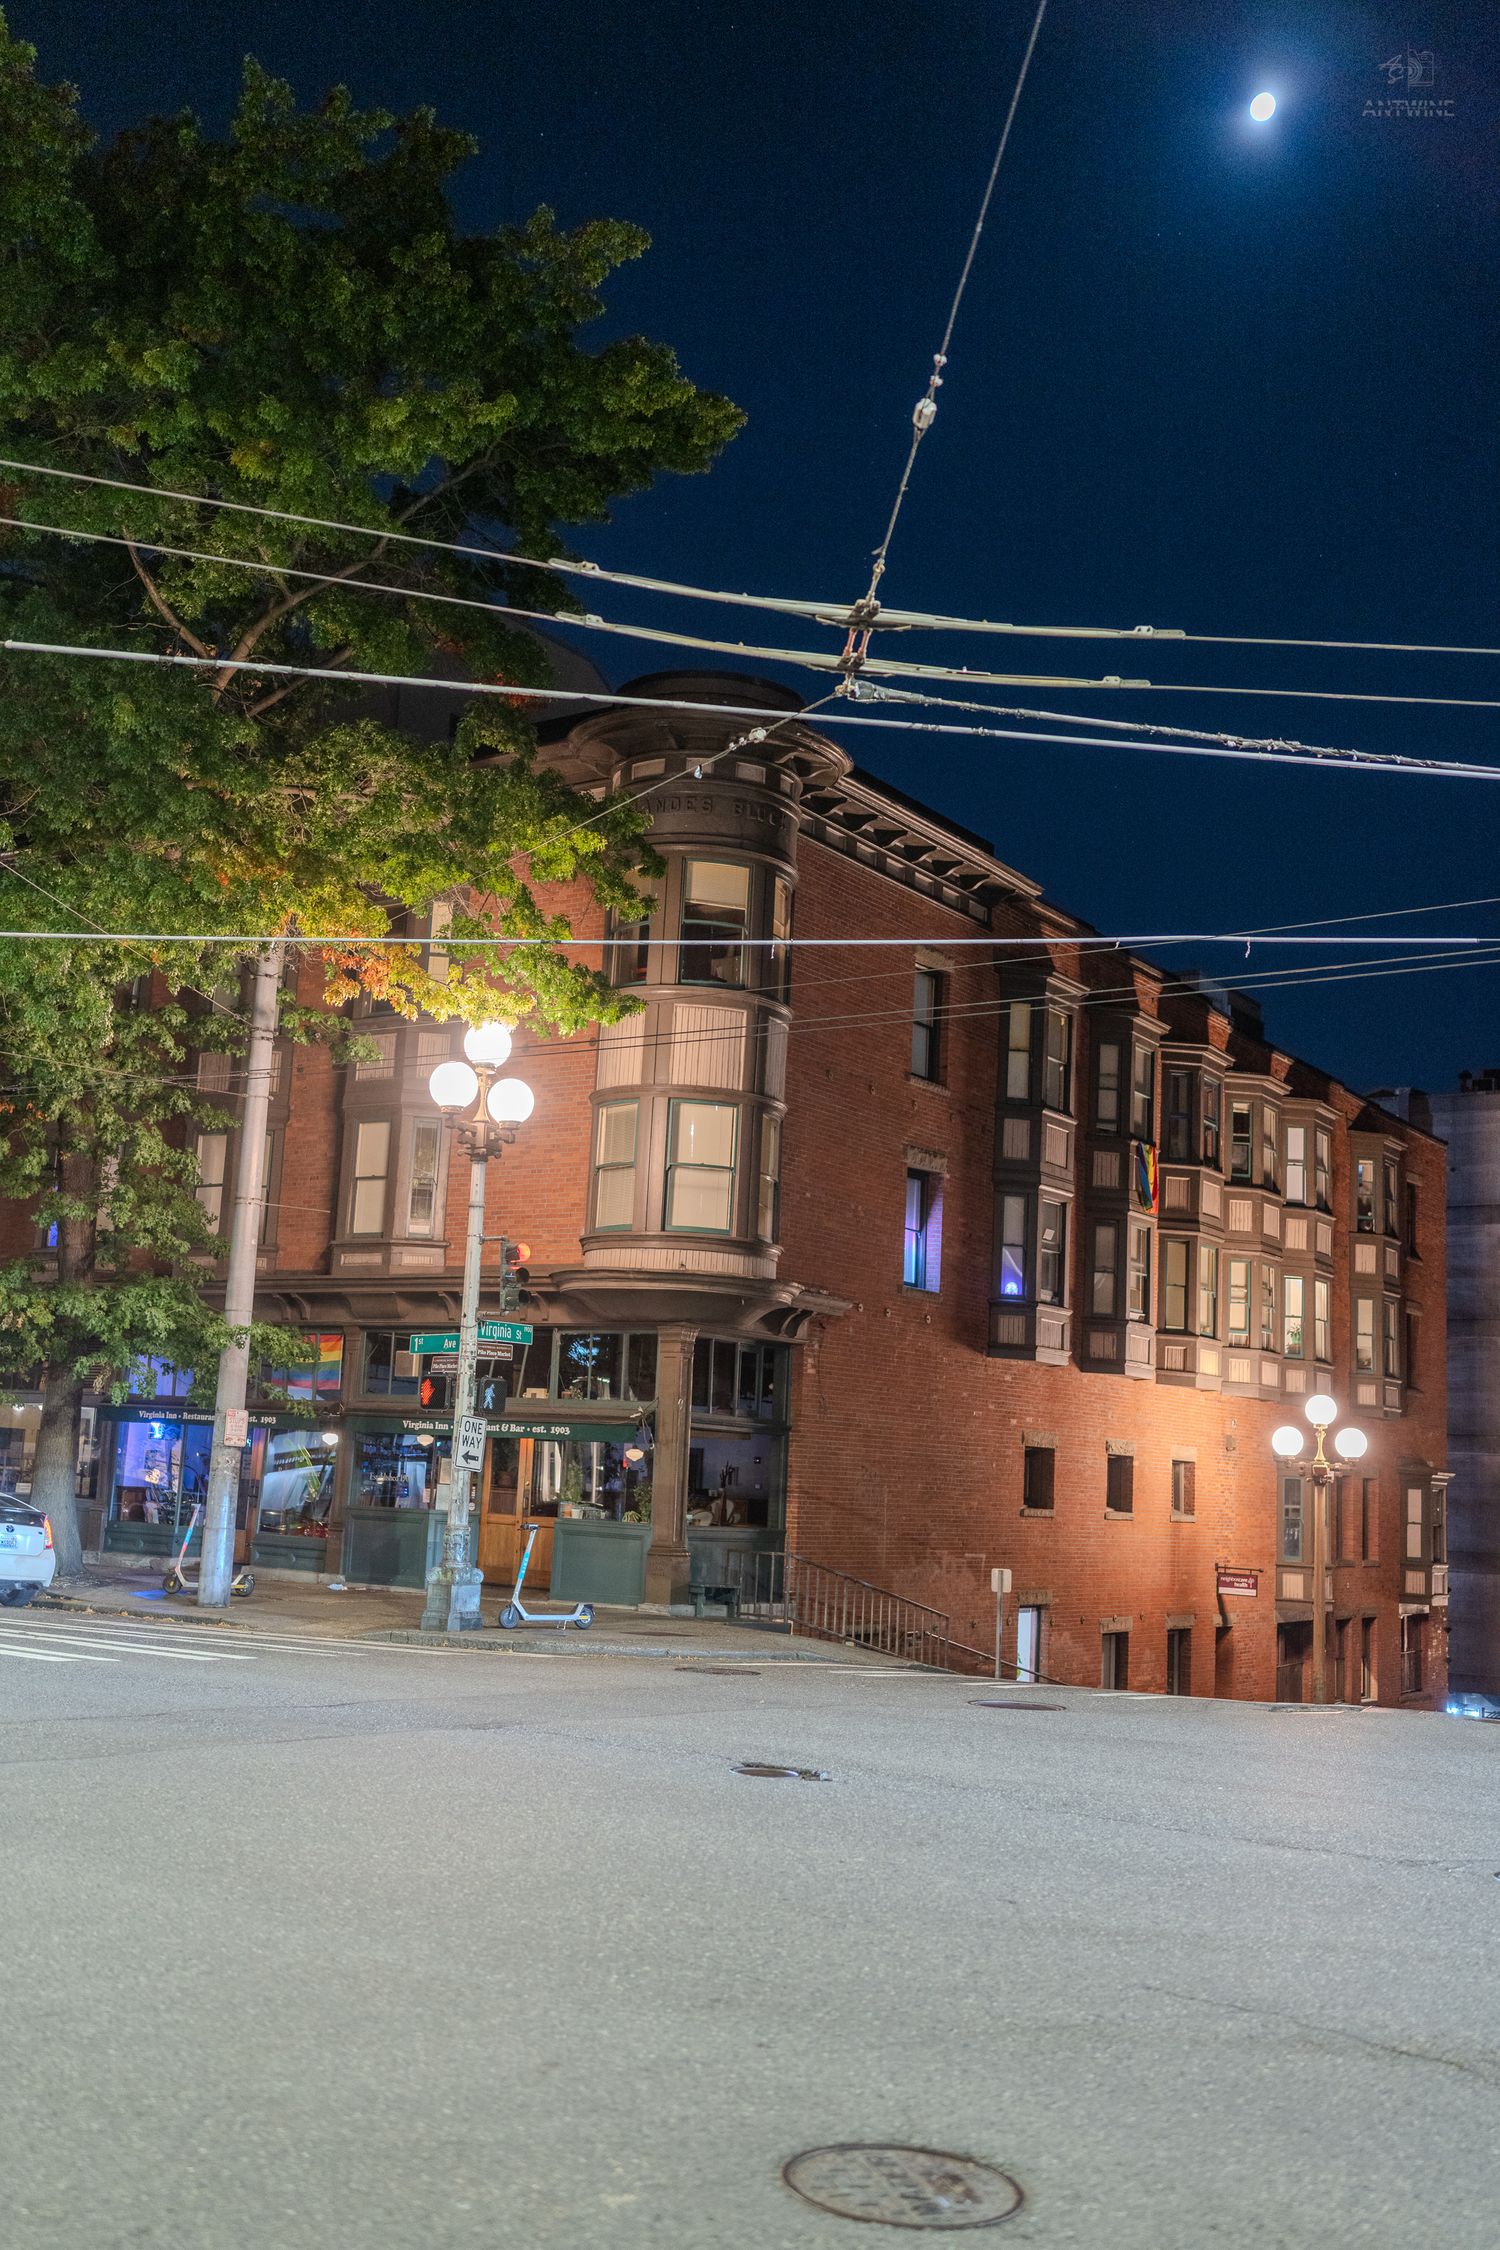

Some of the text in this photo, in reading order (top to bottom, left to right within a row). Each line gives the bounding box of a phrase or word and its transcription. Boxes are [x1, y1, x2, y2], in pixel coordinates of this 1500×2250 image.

[480, 1321, 522, 1340] Virginia St
[414, 1337, 457, 1352] 1st Ave
[138, 1410, 165, 1420] Virginia
[260, 1416, 277, 1424] 1903
[402, 1419, 434, 1431] Virginia
[434, 1422, 449, 1430] Inn
[501, 1423, 510, 1432] &
[510, 1424, 526, 1433] Bar
[532, 1425, 547, 1433] est.
[550, 1426, 571, 1435] 1903
[464, 1420, 483, 1435] ONE
[462, 1434, 482, 1449] WAY
